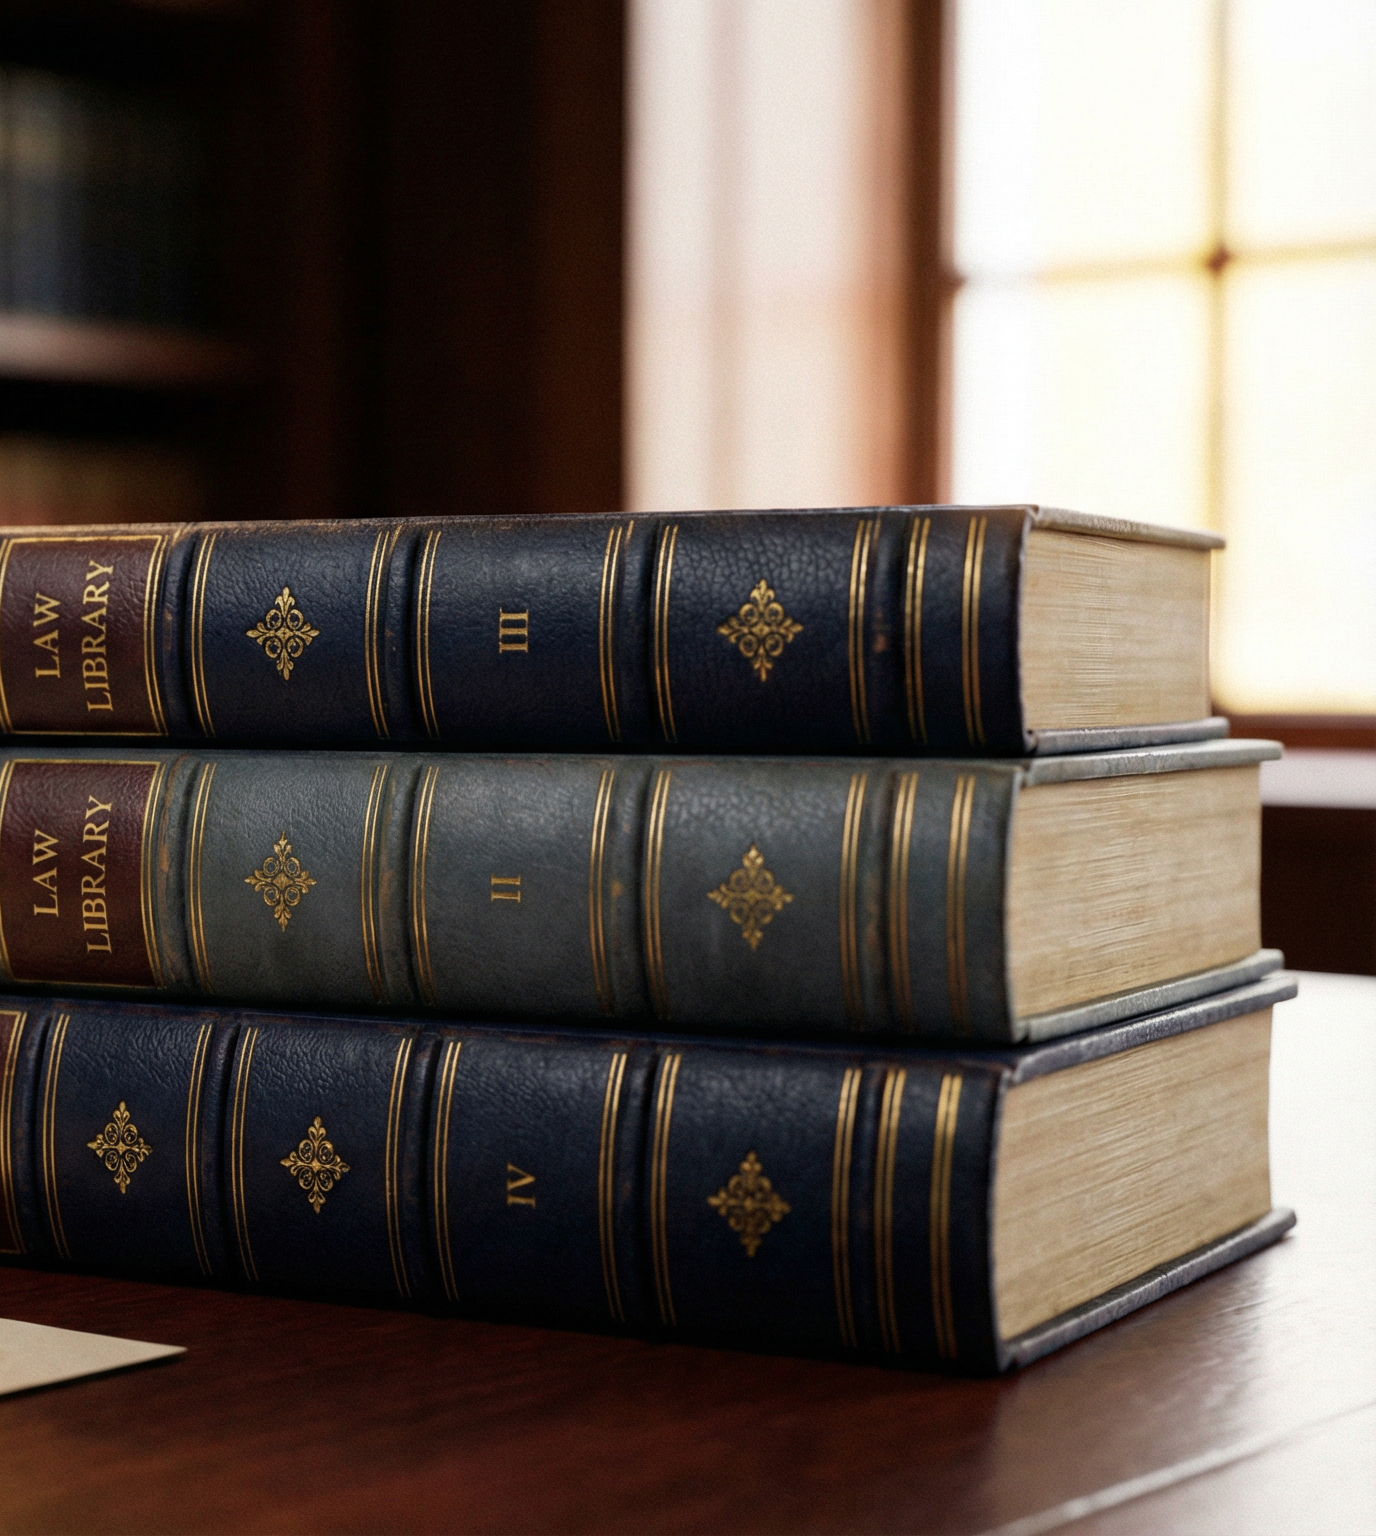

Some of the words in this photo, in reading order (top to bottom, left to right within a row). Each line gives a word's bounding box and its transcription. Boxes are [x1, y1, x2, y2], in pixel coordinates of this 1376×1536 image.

[33, 591, 61, 679] LAW
[81, 560, 114, 712] LIBRARY
[499, 607, 529, 654] III
[32, 828, 60, 918] LAW
[80, 795, 113, 954] LIBRARY
[490, 873, 521, 904] II
[506, 1161, 537, 1210] IV
